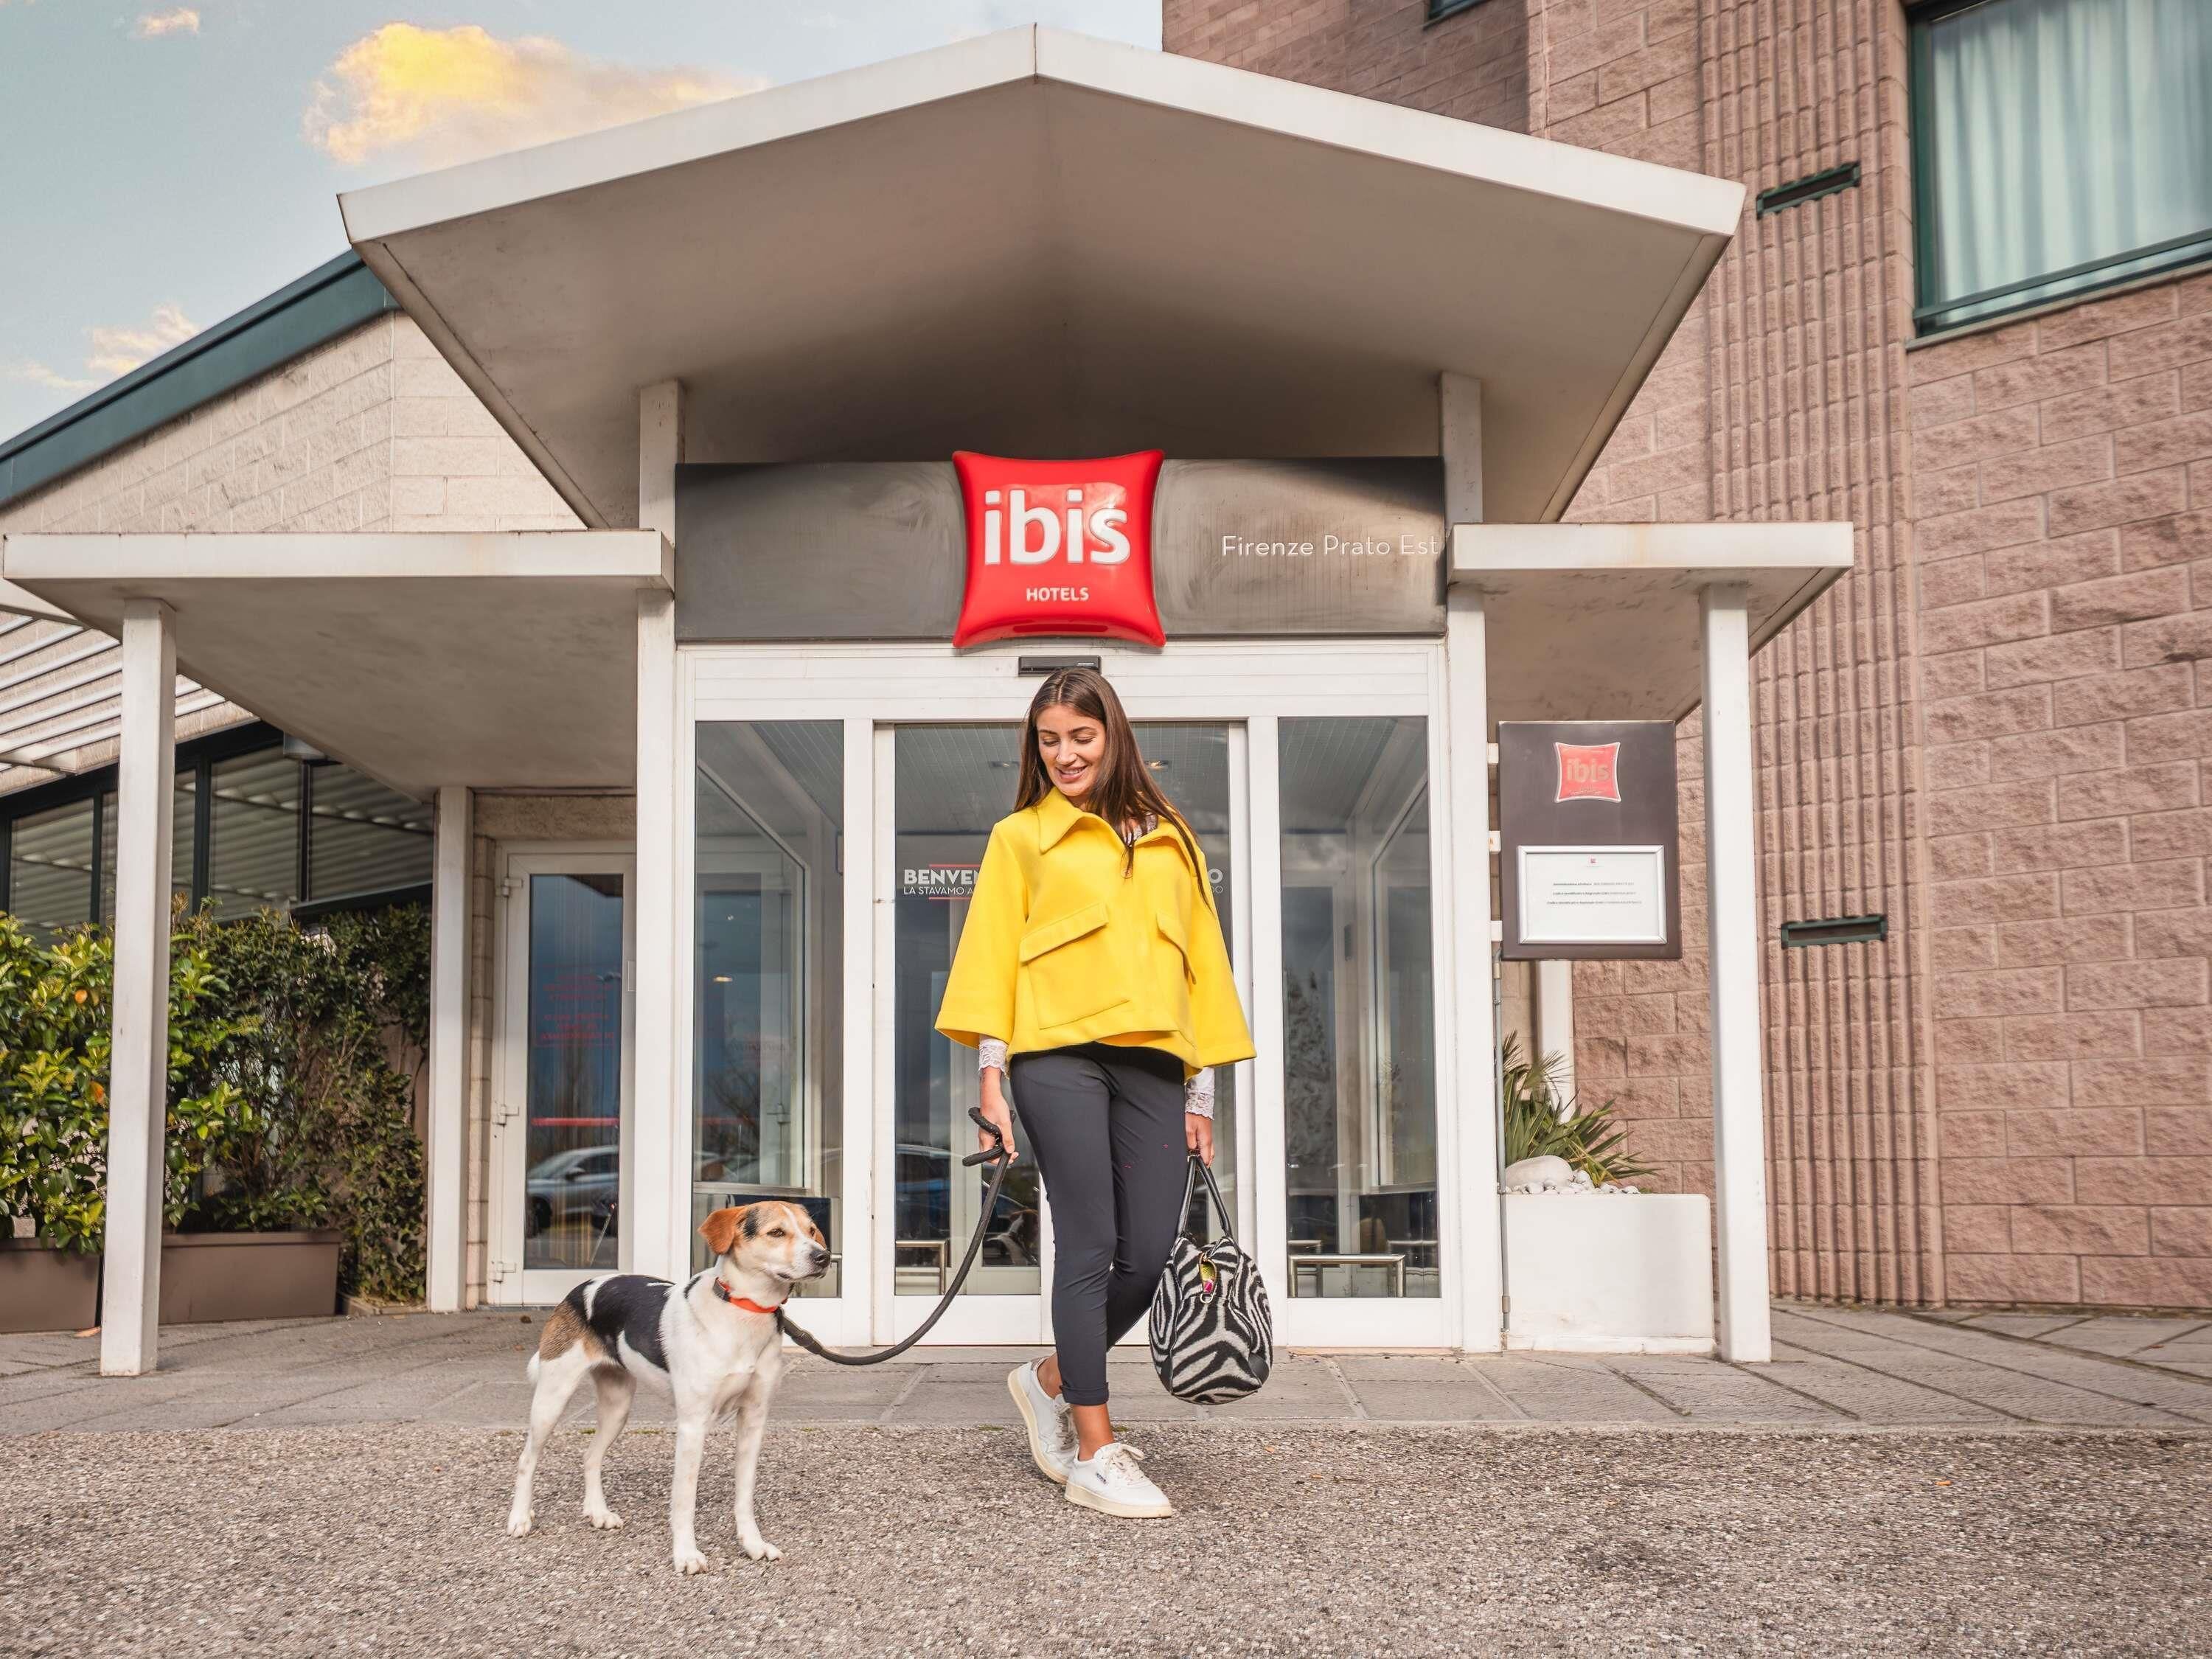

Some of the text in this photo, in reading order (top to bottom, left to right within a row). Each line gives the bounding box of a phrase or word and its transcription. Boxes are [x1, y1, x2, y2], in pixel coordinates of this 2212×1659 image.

[985, 489, 1131, 565] ibis
[1222, 534, 1439, 555] Firenze Prato Est
[1026, 587, 1090, 602] HOTELS
[1567, 759, 1610, 782] ibis
[903, 886, 916, 895] LA
[918, 886, 965, 895] STAVAMO
